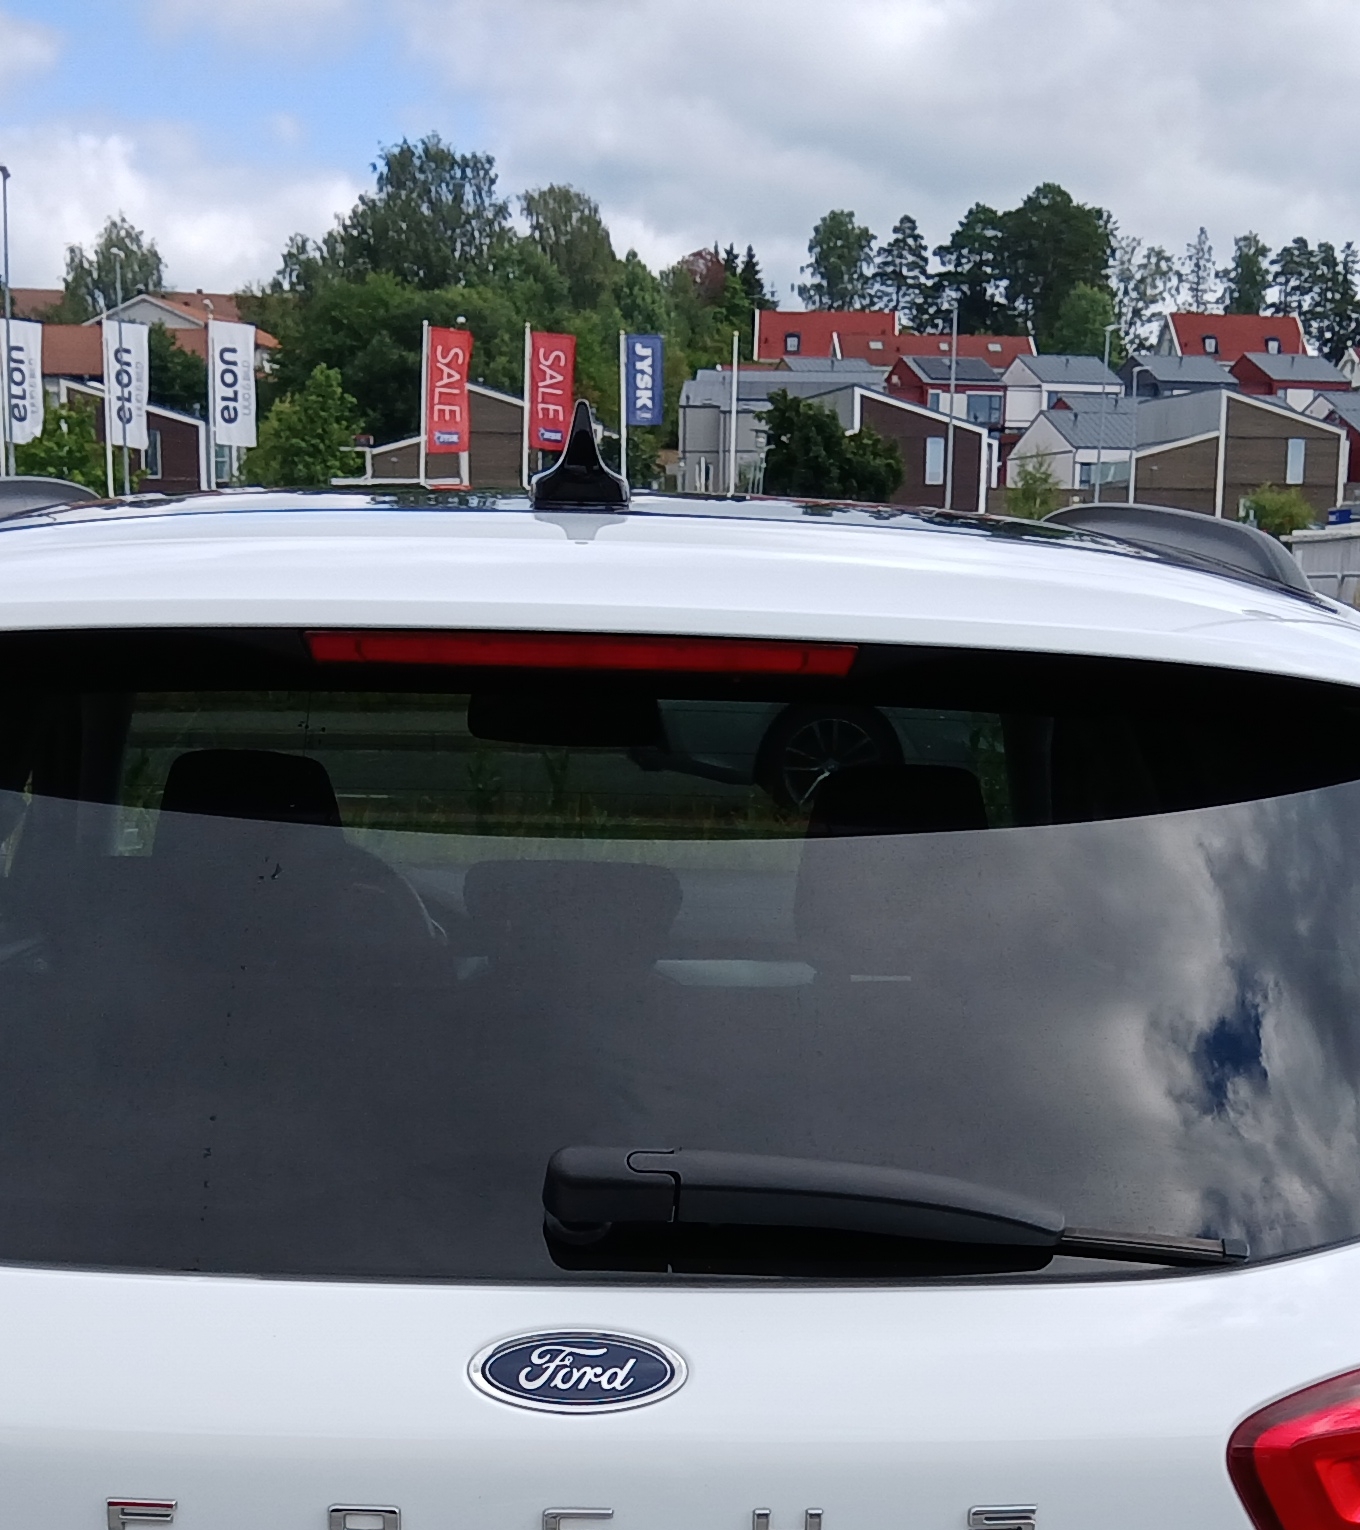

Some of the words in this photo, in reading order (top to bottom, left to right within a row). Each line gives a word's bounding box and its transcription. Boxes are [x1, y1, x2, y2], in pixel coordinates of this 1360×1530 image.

[433, 345, 464, 421] SALE
[537, 347, 566, 421] SALE
[635, 342, 653, 409] JYSK
[518, 1345, 637, 1391] Ford
